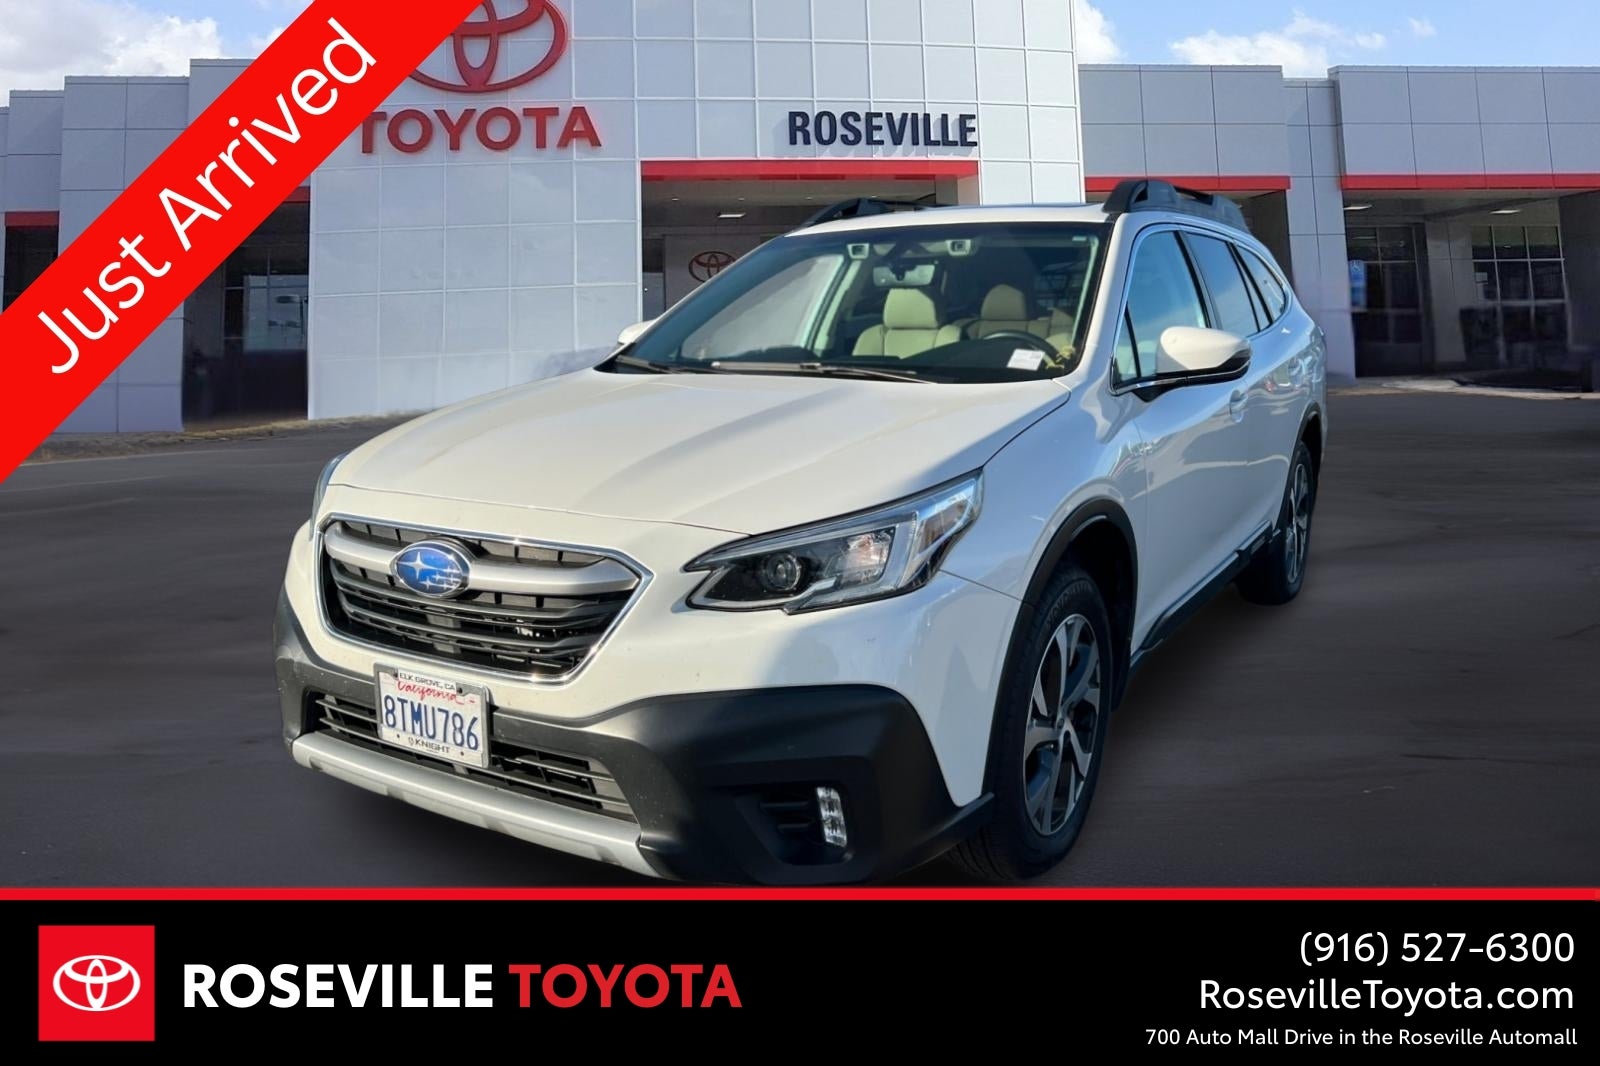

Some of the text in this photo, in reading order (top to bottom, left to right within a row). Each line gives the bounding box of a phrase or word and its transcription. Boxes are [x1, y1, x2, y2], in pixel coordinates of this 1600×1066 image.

[361, 106, 601, 154] TOYOTA
[788, 110, 978, 147] ROSEVILLE
[384, 694, 479, 751] 8TMU786
